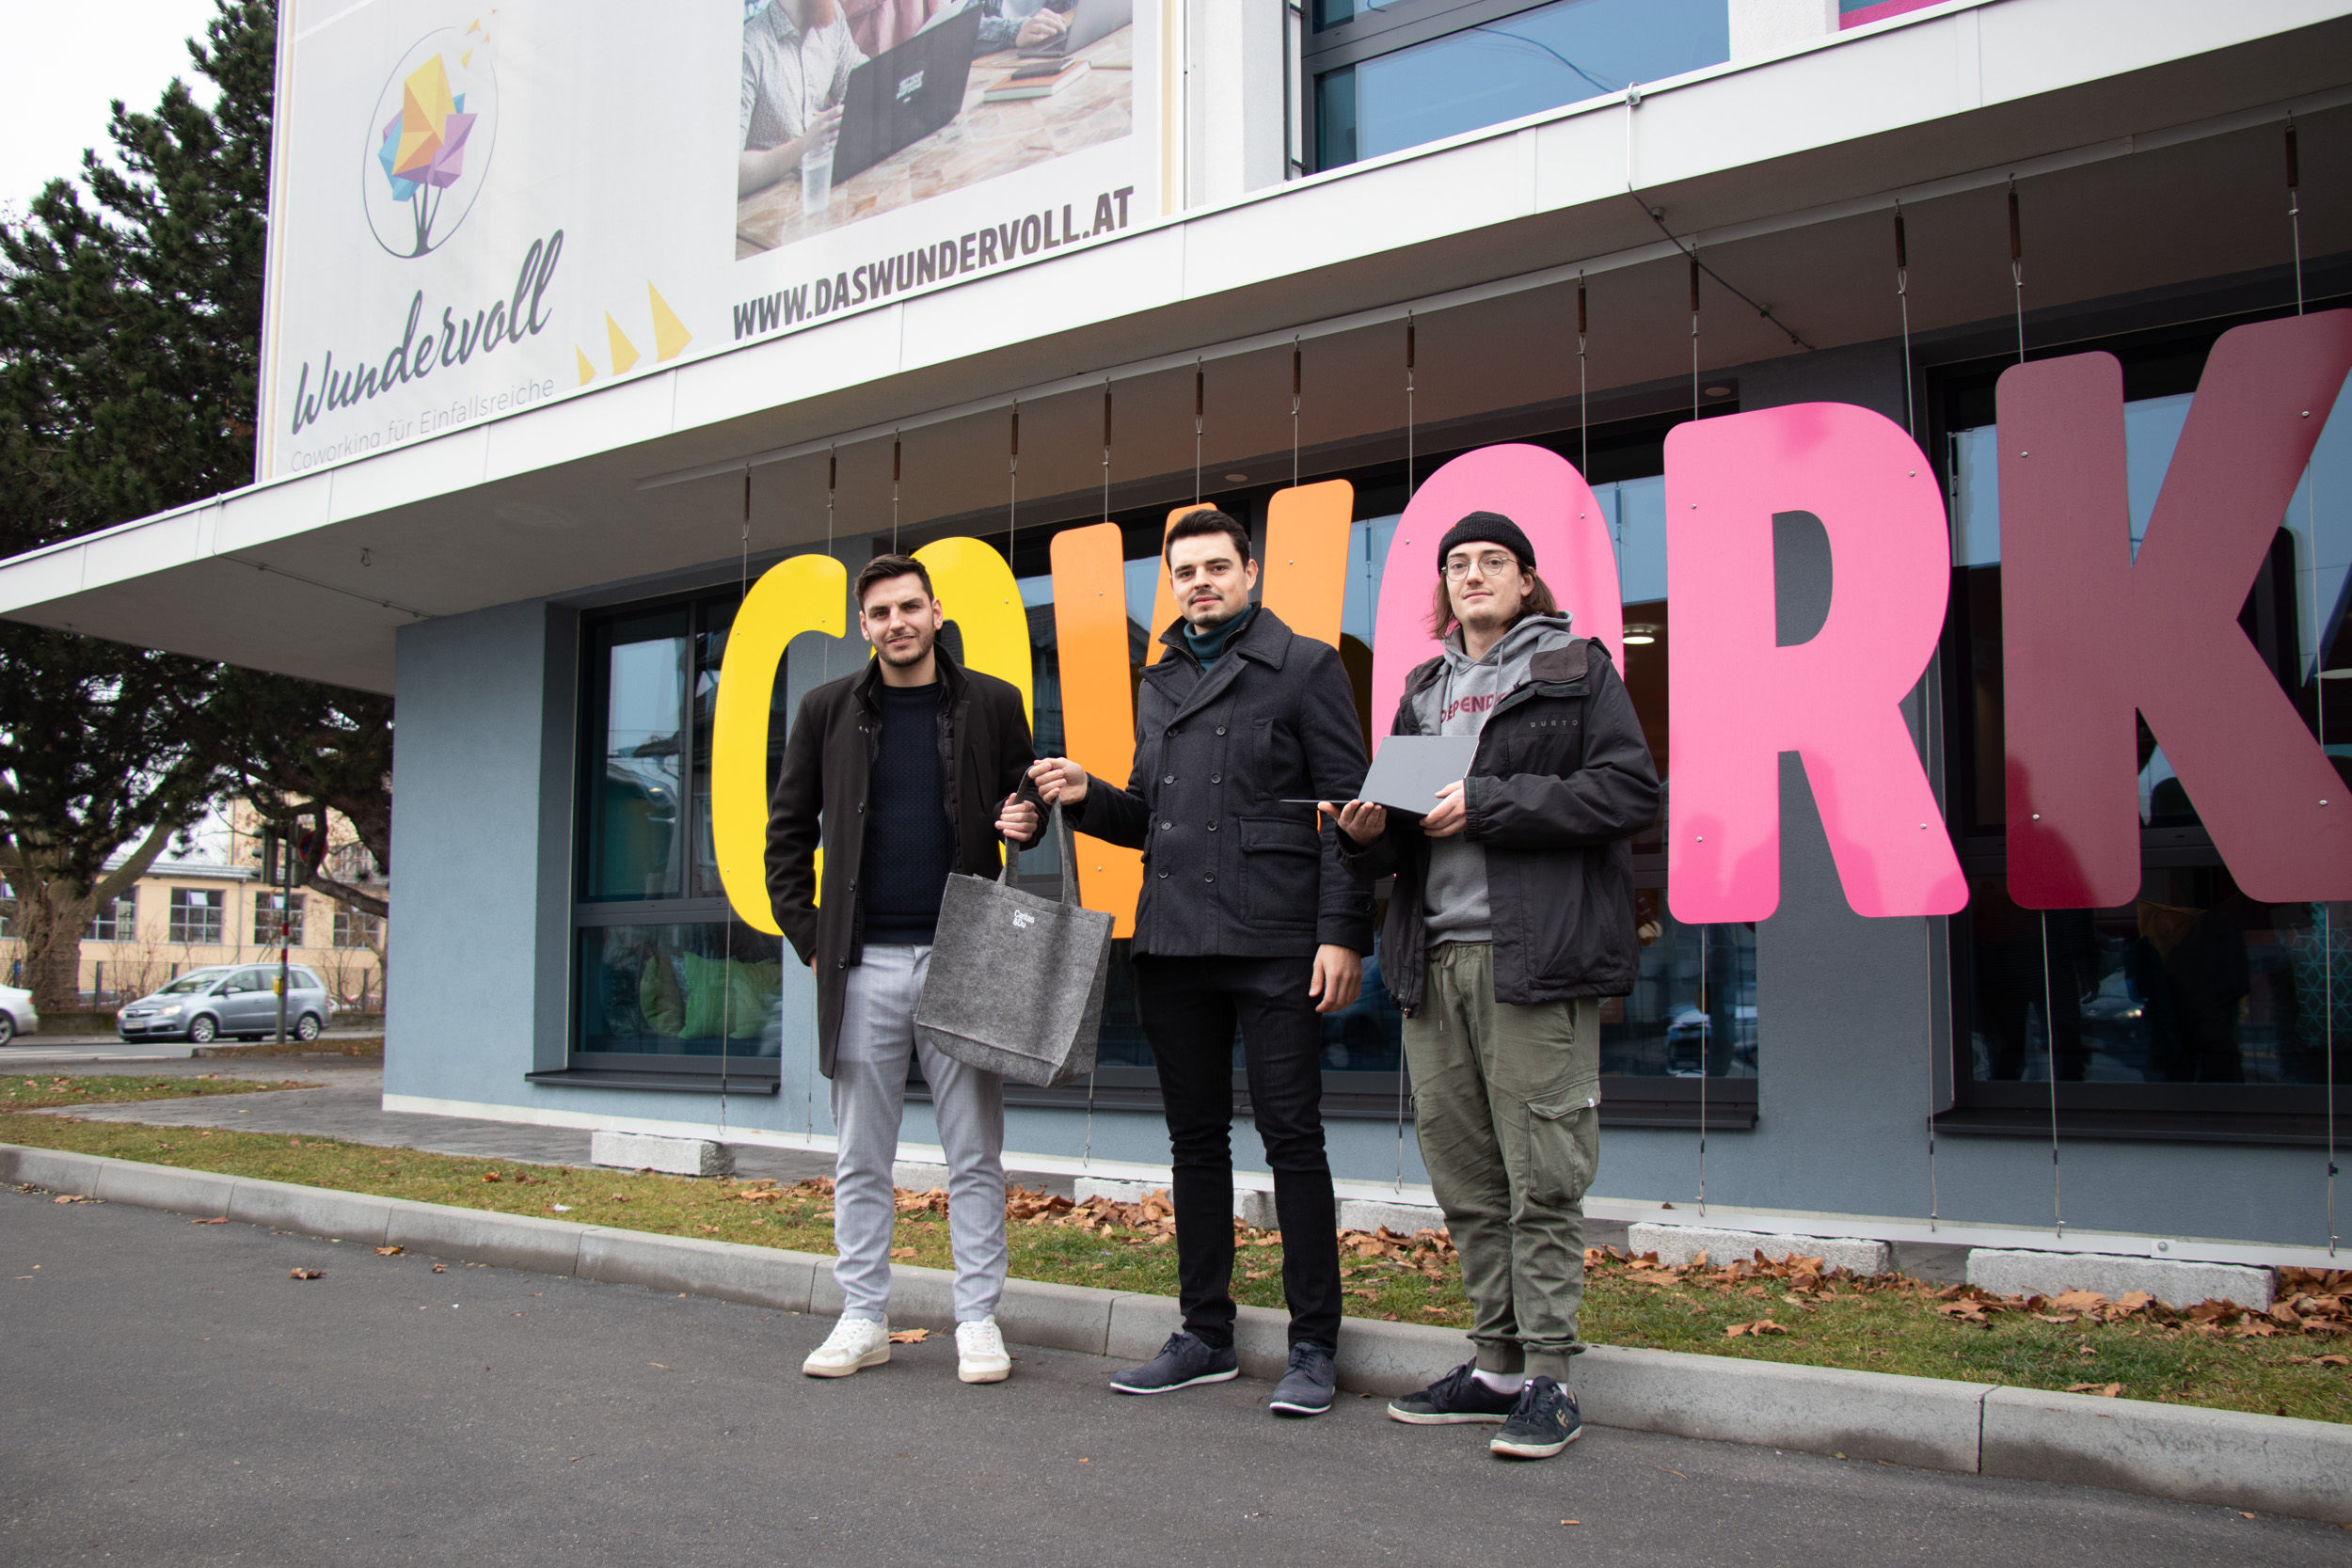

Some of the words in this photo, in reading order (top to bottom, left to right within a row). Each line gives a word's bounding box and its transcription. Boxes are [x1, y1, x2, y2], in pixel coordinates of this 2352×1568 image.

[292, 229, 564, 436] Wundervoll
[733, 185, 1134, 341] WWW.DASWUNDERVOLL.AT
[386, 419, 413, 445] für
[421, 378, 555, 435] Einfallsreiche
[712, 309, 2352, 939] CWORK
